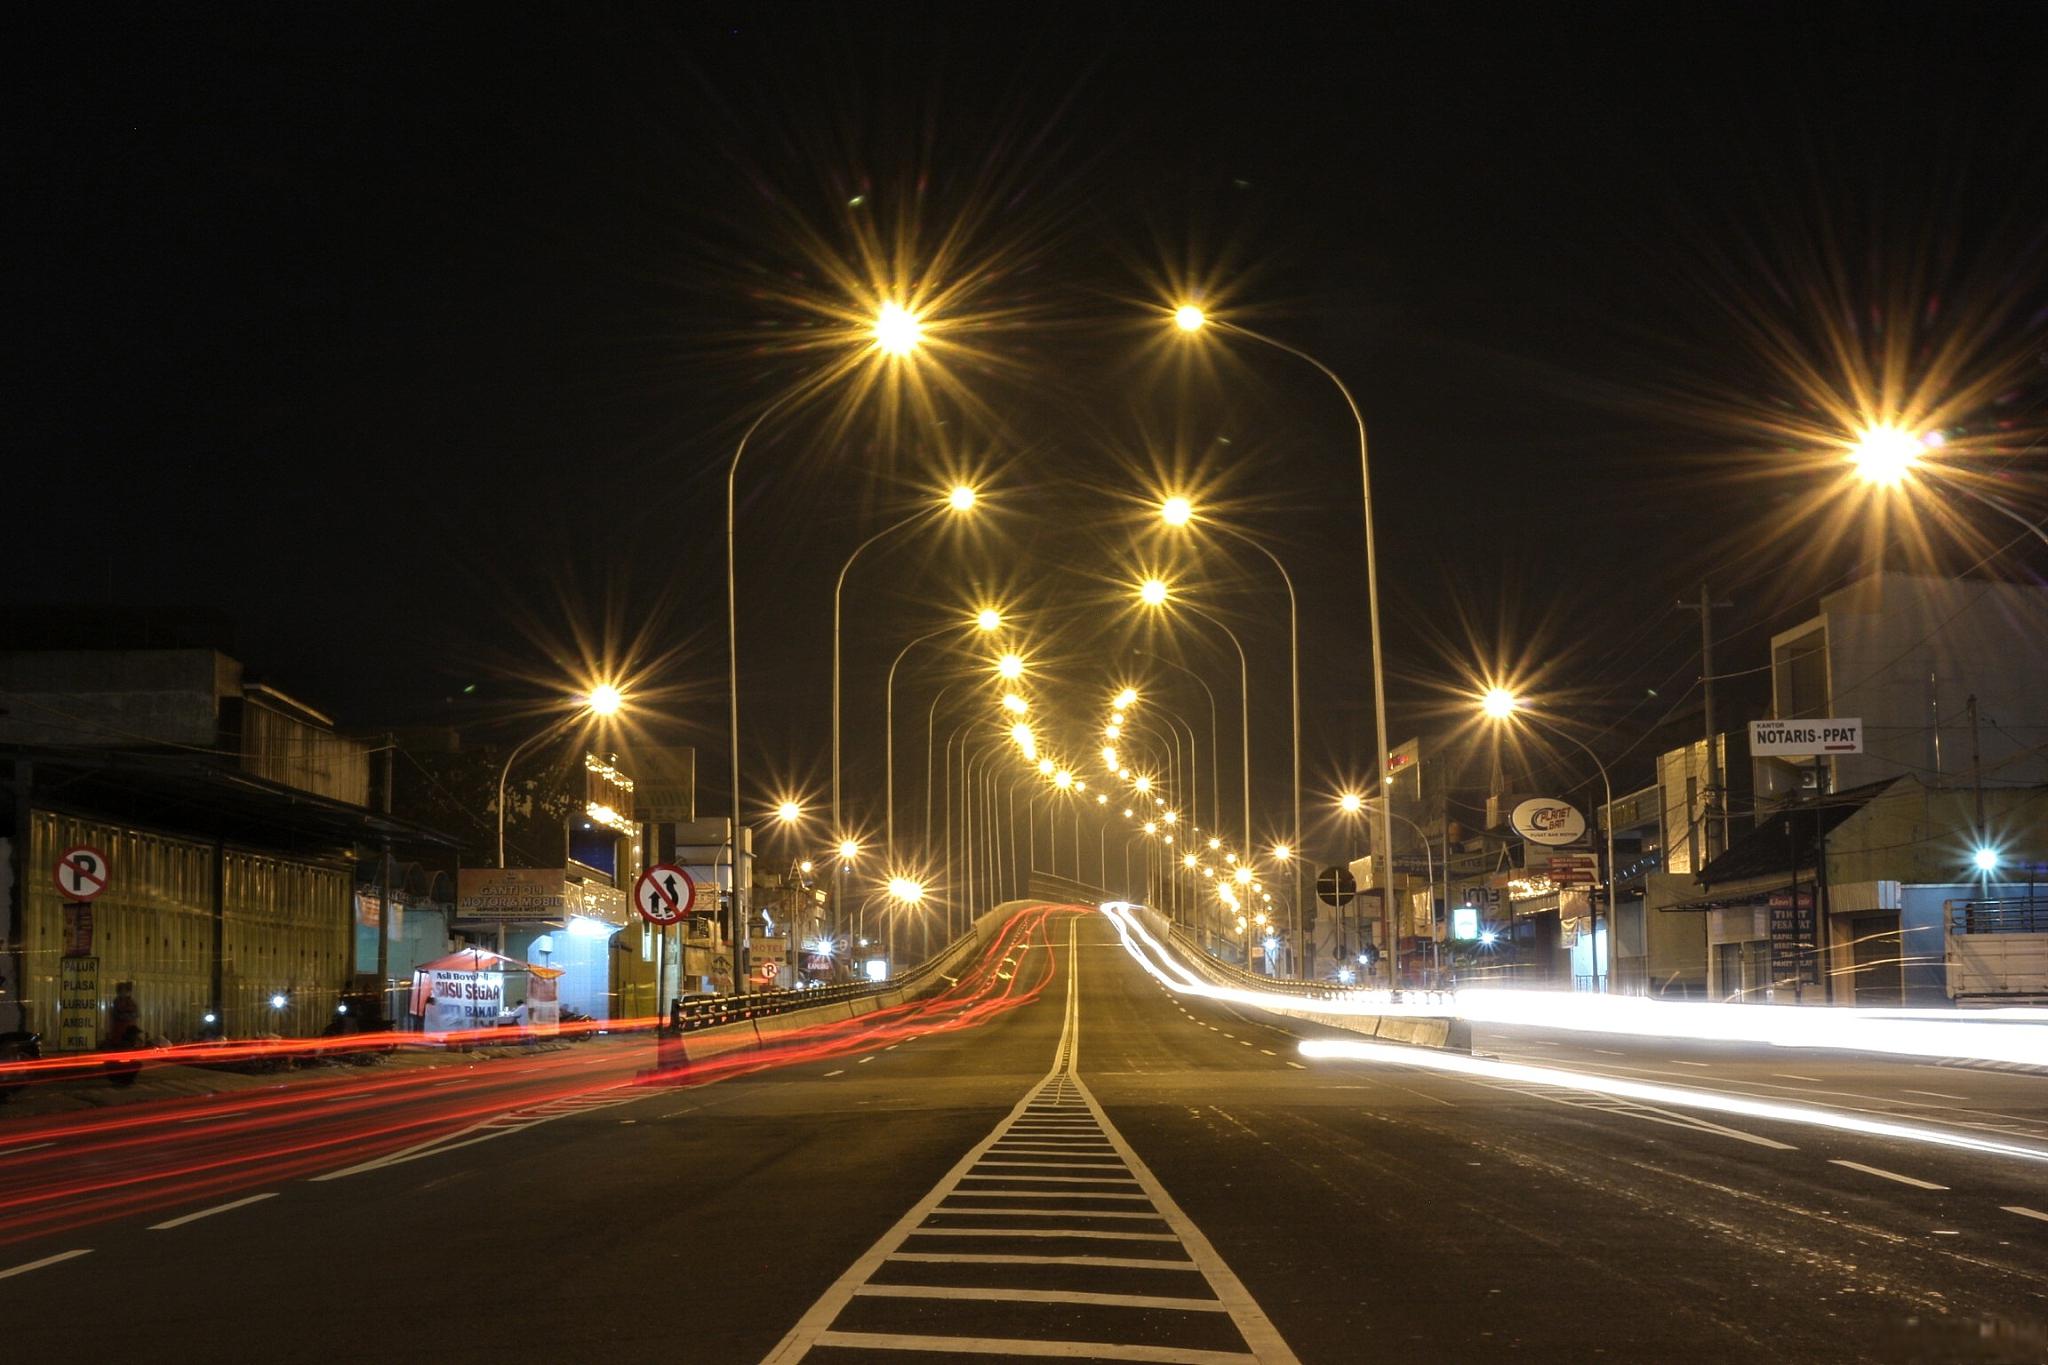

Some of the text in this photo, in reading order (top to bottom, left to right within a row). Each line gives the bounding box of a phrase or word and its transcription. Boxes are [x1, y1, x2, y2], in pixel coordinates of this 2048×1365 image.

[1548, 819, 1565, 830] BAN
[73, 854, 97, 891] P
[480, 885, 518, 896] GANTI
[522, 896, 561, 907] MOBIL
[752, 944, 785, 953] HOTEL
[64, 960, 95, 973] PALUR
[437, 972, 452, 980] Asli
[63, 980, 95, 992] PLASA
[436, 982, 463, 999] SUSU
[63, 999, 95, 1010] LURUS
[465, 1005, 498, 1018] BAKAR
[63, 1016, 94, 1029] AMBIL
[68, 1036, 88, 1048] KIRI
